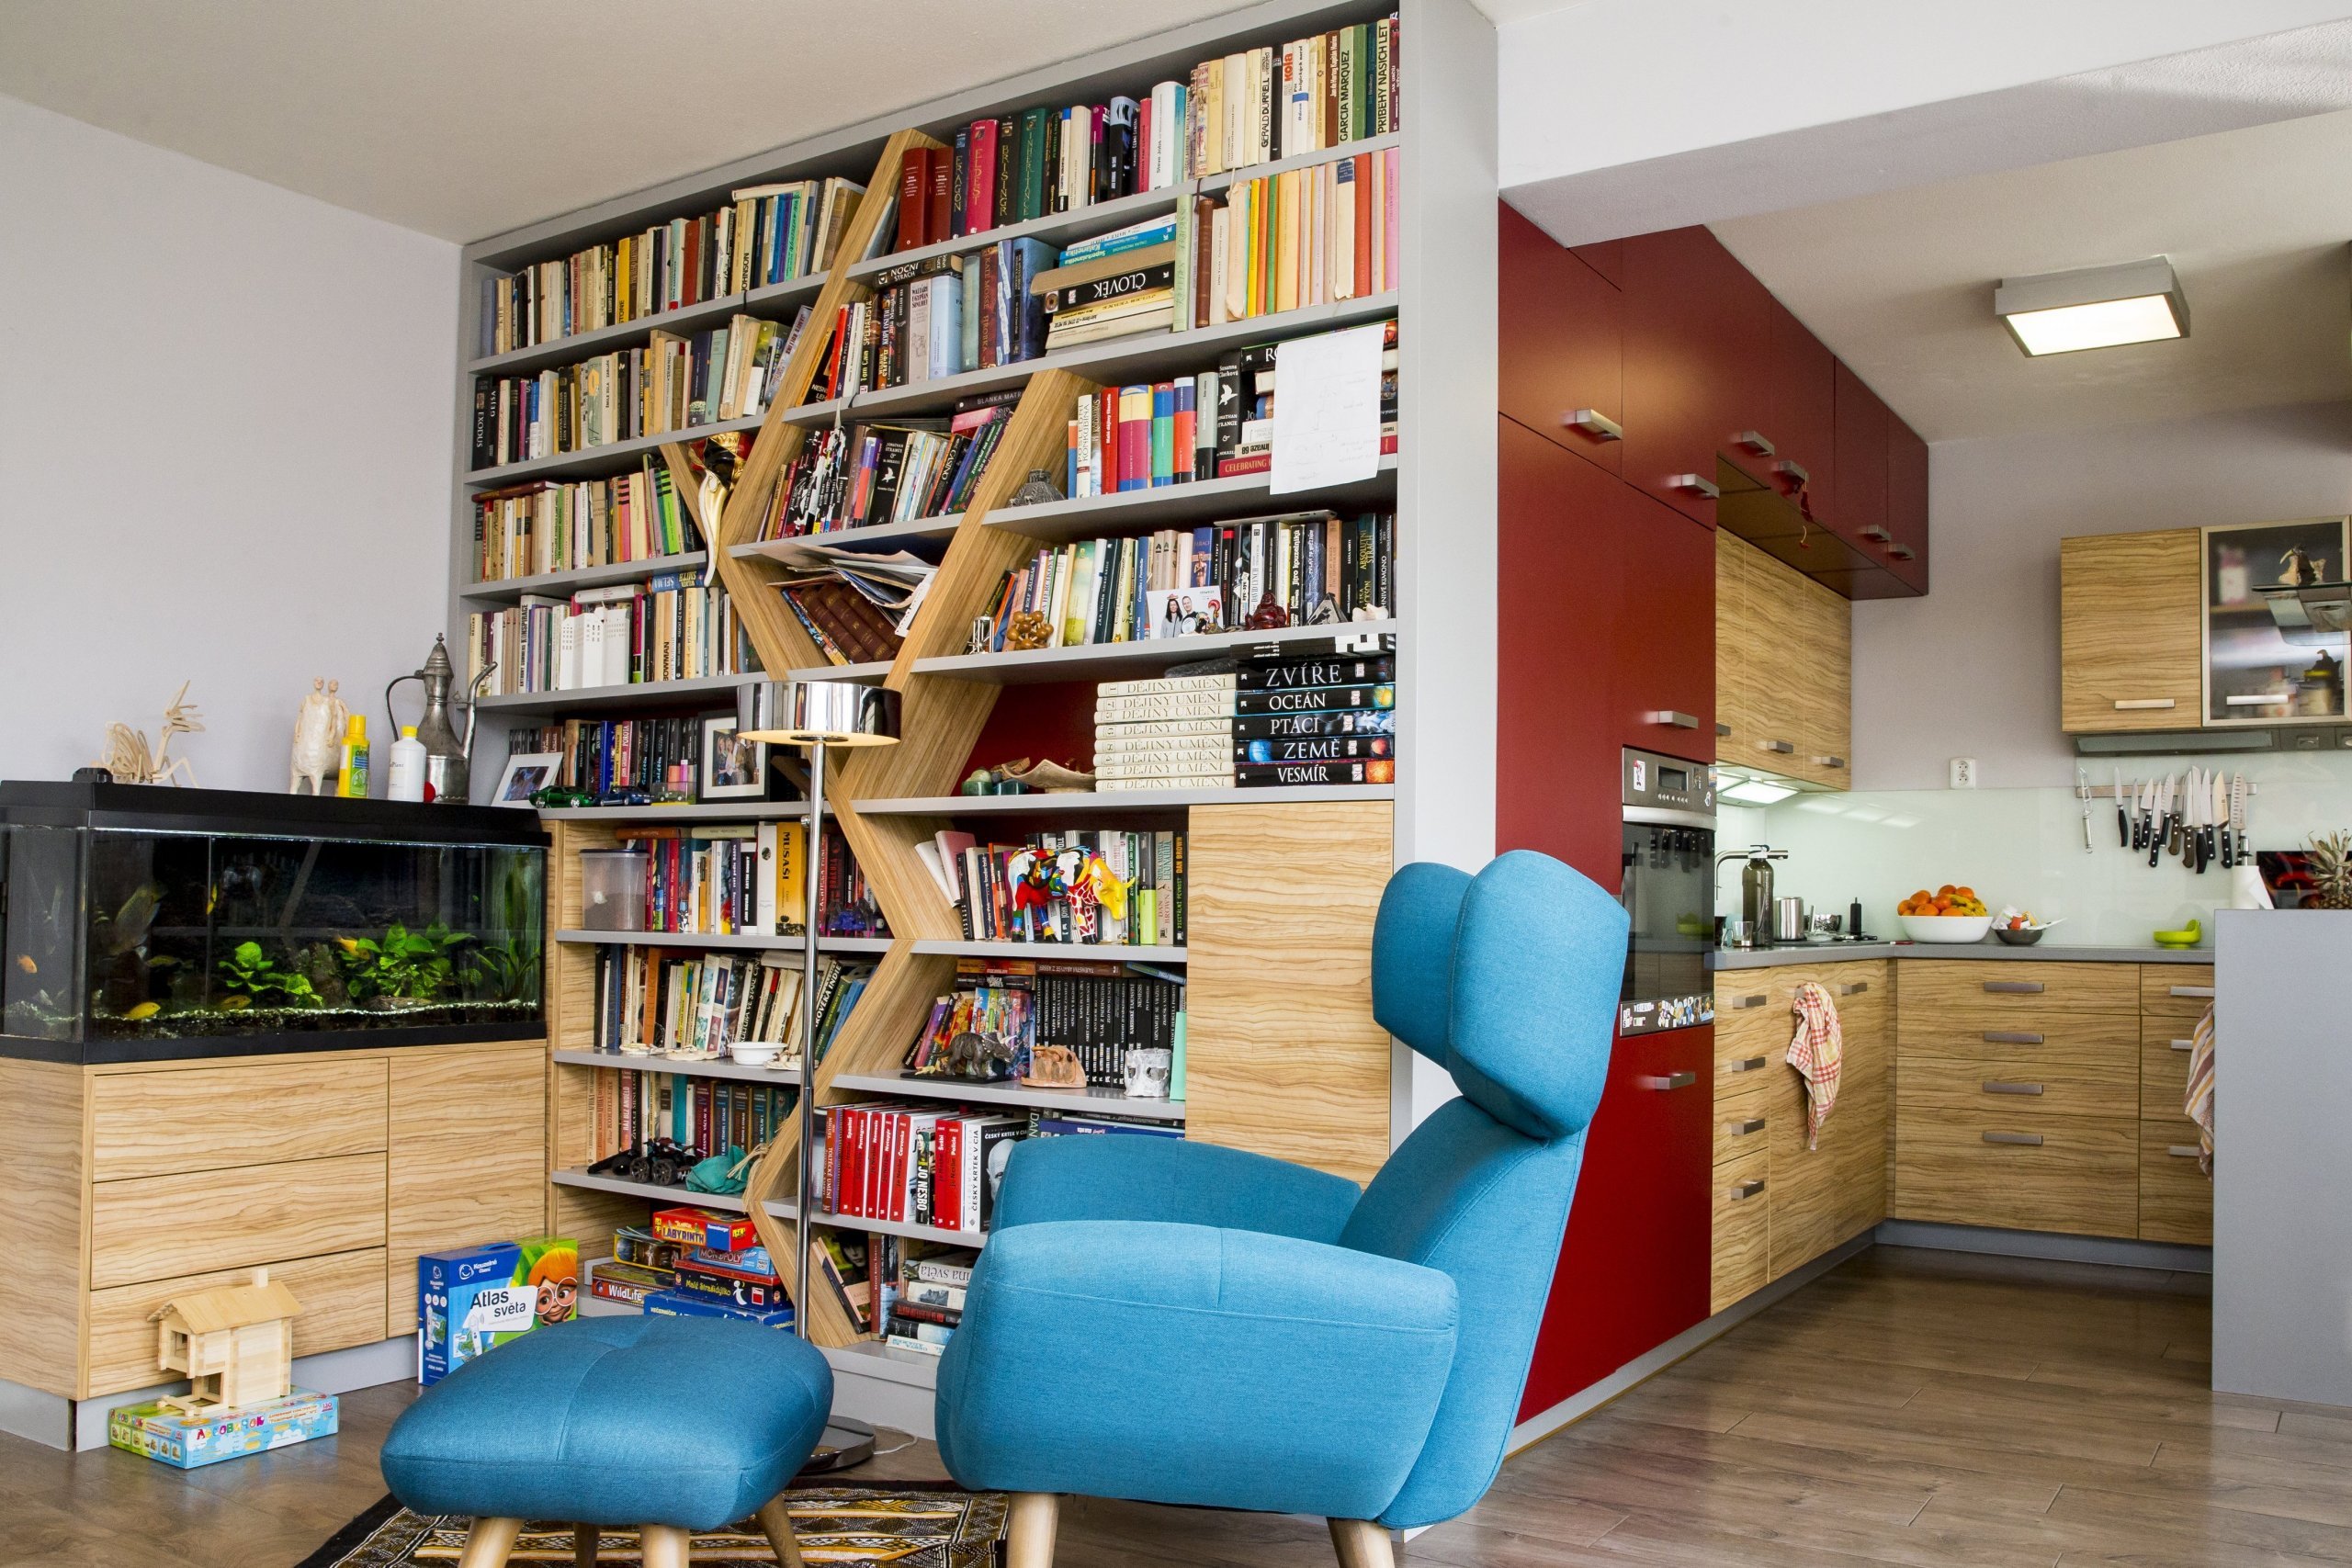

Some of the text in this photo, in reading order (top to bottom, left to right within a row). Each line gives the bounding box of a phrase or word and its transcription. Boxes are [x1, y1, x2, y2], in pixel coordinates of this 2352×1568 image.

[1378, 25, 1387, 44] LET
[1283, 52, 1294, 82] Kola
[1340, 50, 1351, 101] MARQUEZ
[1261, 77, 1270, 115] DURRELL
[1261, 115, 1270, 148] GERALD
[954, 155, 963, 212] ERAGON
[972, 149, 983, 206] ELDEST
[1000, 143, 1010, 217] BRISINGR
[1064, 250, 1106, 265] Superkalanetika
[741, 253, 750, 290] JOHNSON
[893, 271, 916, 282] STRACH
[1093, 273, 1147, 299] ČLOVĚK
[864, 300, 873, 346] SPECIALISTA
[981, 315, 989, 354] HROBKA
[862, 350, 870, 366] Cain
[977, 395, 1002, 405] BLANKA
[476, 412, 484, 447] EXODUS
[1241, 443, 1270, 455] Invaze 68
[941, 449, 956, 480] CASINO
[1225, 458, 1267, 473] CELEBRATING
[1366, 535, 1374, 564] STRACH
[1251, 567, 1260, 586] LYNCH
[1292, 570, 1300, 586] Jitro
[1265, 661, 1342, 687] ZVÍŘE
[1127, 674, 1227, 694] DĚJINY UMĚNÍ
[1124, 696, 1171, 709] DĚJINY
[1175, 691, 1221, 705] UMĚNÍ
[1269, 692, 1326, 710] OCEÁN
[1122, 705, 1221, 719] DĚJINY UMĚNÍ
[1124, 719, 1223, 736] DĚJINY UMĚNÍ
[1270, 716, 1319, 735] PTÁCI
[1125, 735, 1226, 750] DĚJINY UMĚNÍ
[1283, 739, 1340, 759] ZEMĚ
[1122, 750, 1223, 763] DĚJINY UMĚNÍ
[1123, 762, 1223, 775] DĚJINY UMĚNÍ
[1277, 764, 1329, 783] VESMÍR
[1125, 777, 1225, 789] DĚJINY UMĚNÍ
[782, 831, 791, 881] MUSAŠI
[827, 964, 842, 988] INDIE
[844, 1116, 853, 1139] Spasitel
[984, 1132, 998, 1141] ČESKÝ
[998, 1131, 1012, 1139] KRTEK
[897, 1130, 905, 1156] Červenka
[918, 1166, 928, 1179] JO
[970, 1182, 978, 1212] ČESKÝ
[662, 1227, 706, 1243] LABYRINTH
[473, 1258, 498, 1269] Kouzelné
[699, 1247, 742, 1262] MONOPOLY
[921, 1266, 950, 1281] světa
[685, 1280, 698, 1291] Malé
[469, 1291, 509, 1310] Atlas
[493, 1302, 526, 1317] světa
